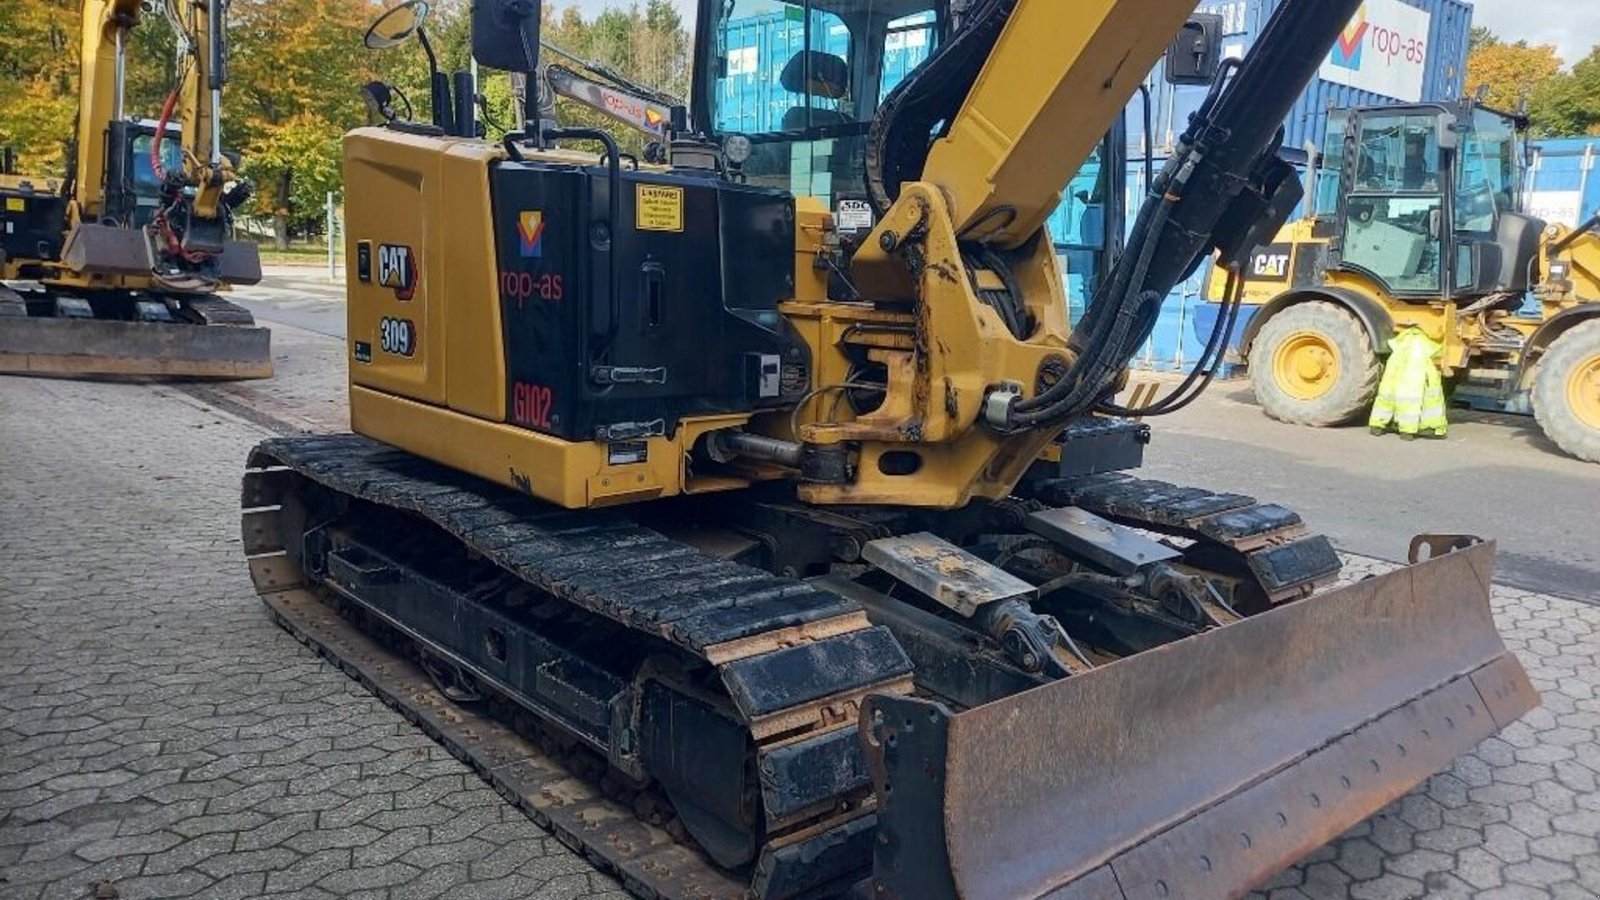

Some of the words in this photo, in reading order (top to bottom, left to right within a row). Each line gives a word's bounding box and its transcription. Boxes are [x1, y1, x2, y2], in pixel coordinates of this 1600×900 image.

[1371, 25, 1424, 67] rop-as
[379, 245, 408, 288] CAT
[1254, 254, 1289, 276] CAT
[501, 272, 562, 310] rop-as
[381, 318, 409, 354] 309
[514, 381, 551, 429] G102
